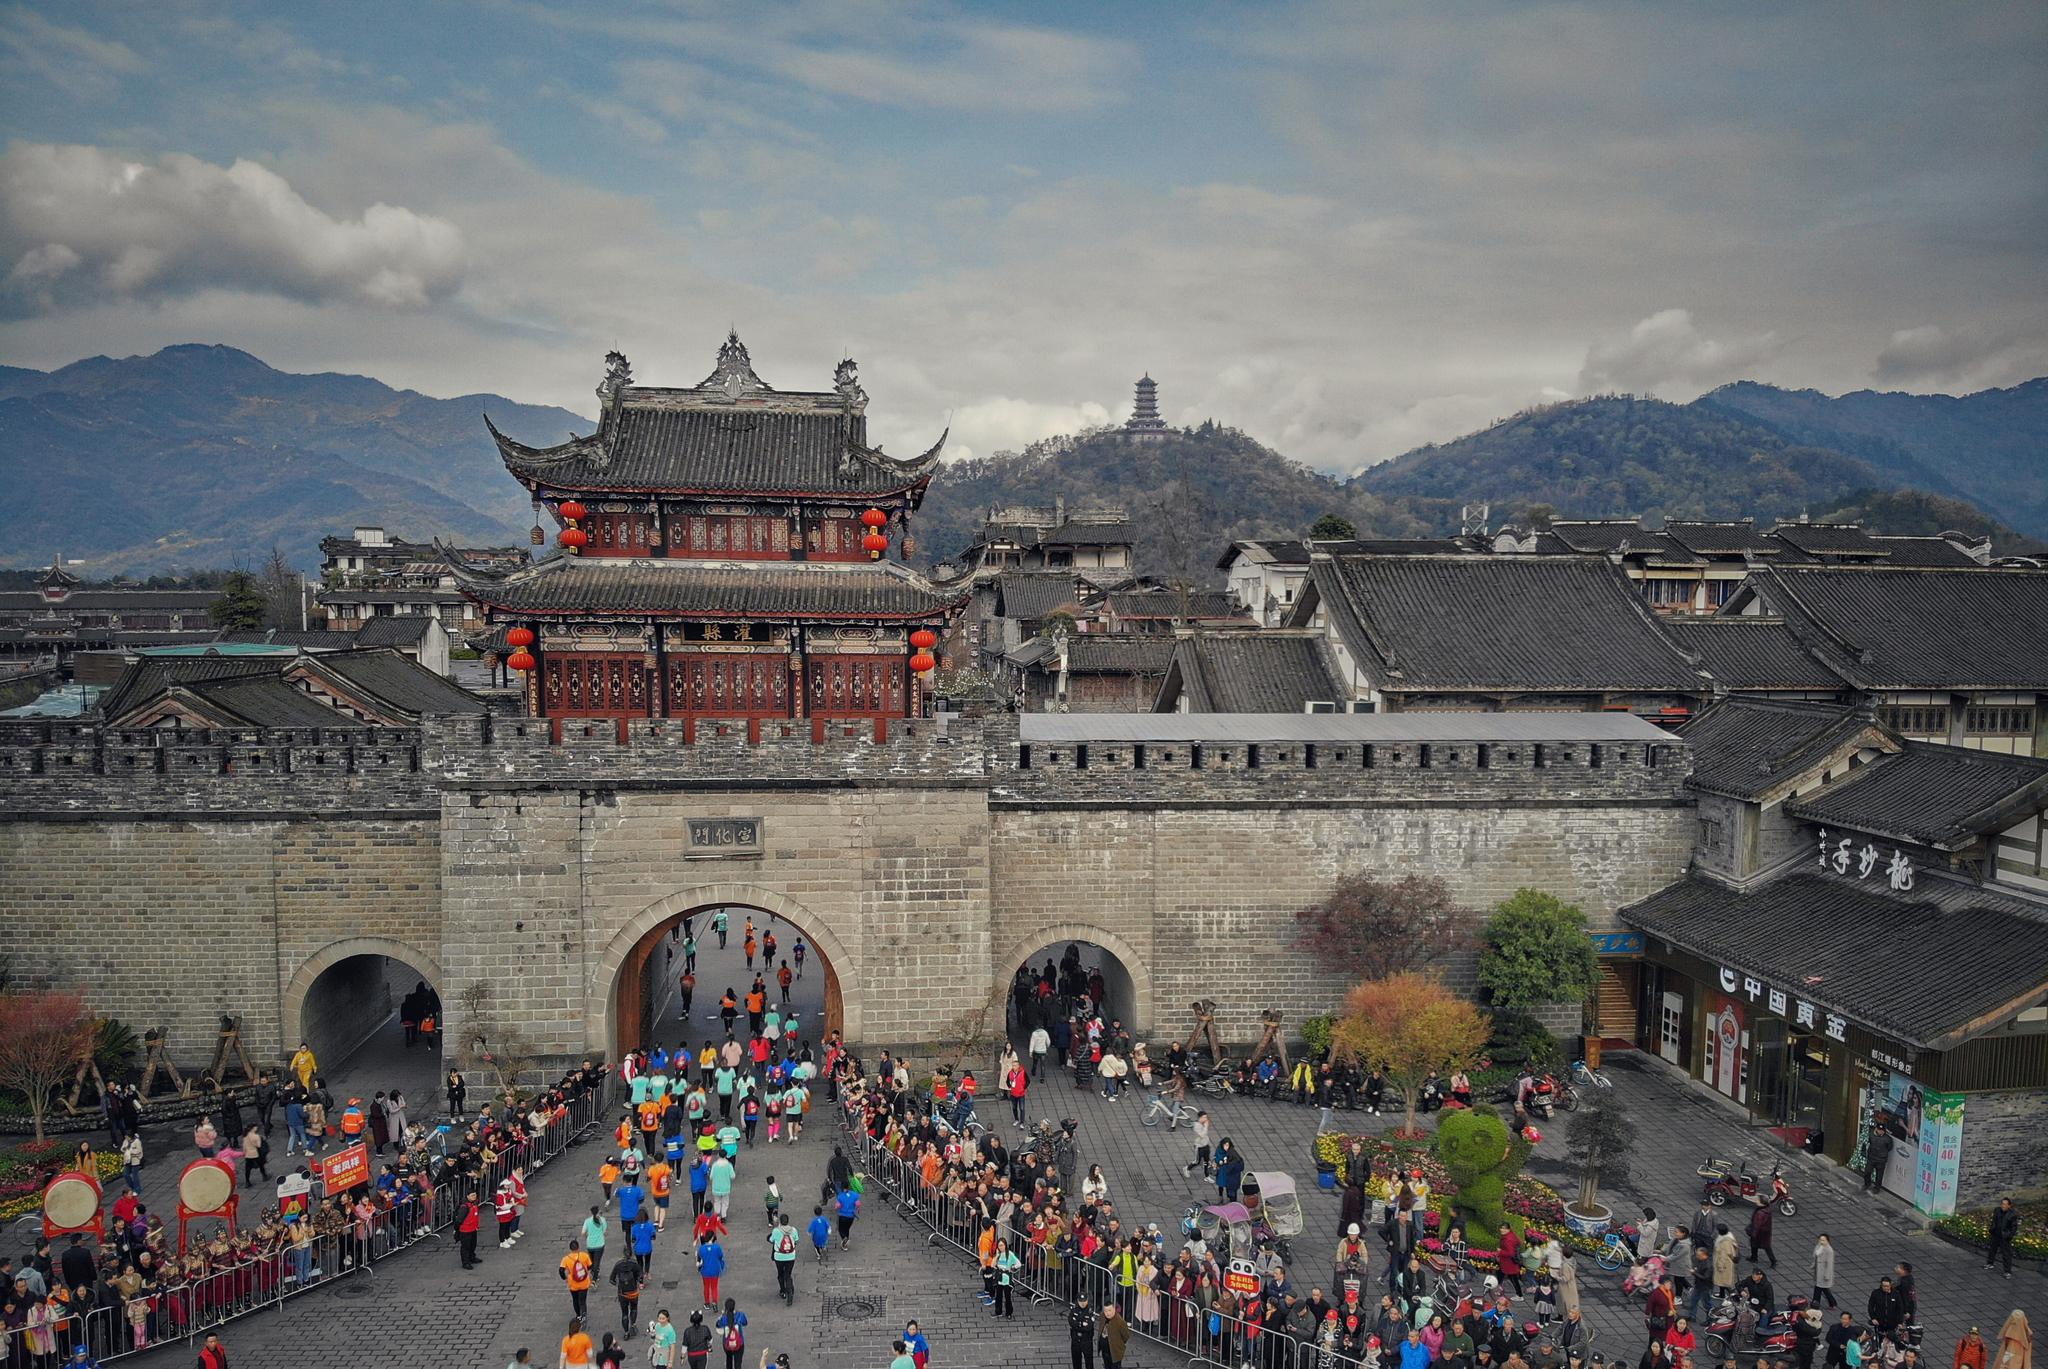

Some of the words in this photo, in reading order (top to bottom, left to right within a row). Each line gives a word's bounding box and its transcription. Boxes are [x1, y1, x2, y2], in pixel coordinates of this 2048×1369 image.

[1744, 977, 1847, 1043] 中国黄金
[1871, 1049, 1912, 1075] 都江堰形象店
[332, 1156, 360, 1175] 老凤祥
